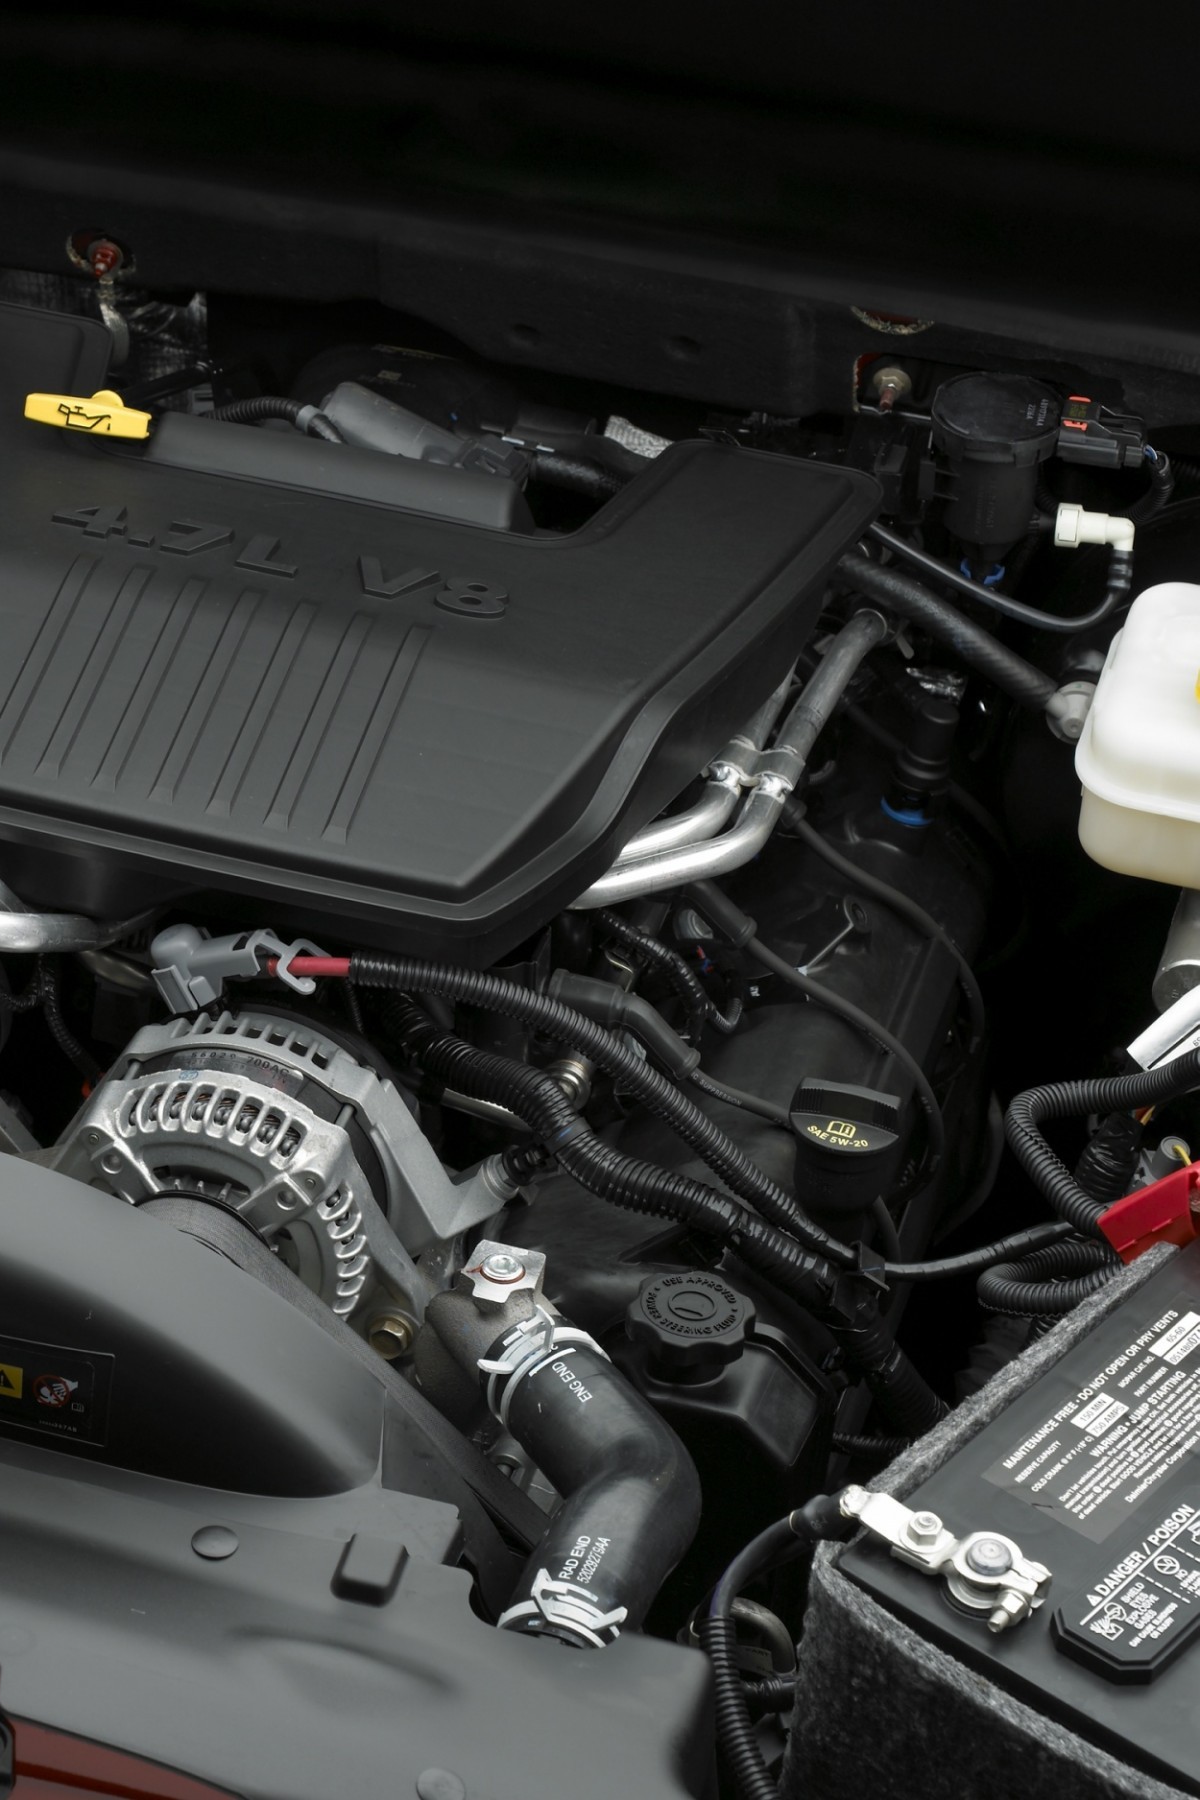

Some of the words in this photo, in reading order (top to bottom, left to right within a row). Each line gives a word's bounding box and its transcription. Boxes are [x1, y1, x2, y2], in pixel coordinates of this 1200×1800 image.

[51, 506, 299, 579] 4.7L
[358, 555, 510, 621] V8
[699, 1079, 742, 1106] SUPPRESSION
[807, 1125, 828, 1141] SAE
[829, 1134, 869, 1148] 5W-20
[662, 1276, 684, 1287] USE
[686, 1277, 737, 1304] APPROVED
[660, 1318, 713, 1335] STEERING
[551, 1361, 575, 1384] END
[1134, 1385, 1150, 1397] PART
[1145, 1366, 1169, 1386] NUMBER
[569, 1380, 594, 1403] ENG
[1003, 1420, 1060, 1469] MAINTENANCE
[1055, 1402, 1079, 1422] FREE
[1078, 1389, 1094, 1400] DO
[1089, 1375, 1109, 1390] NOT
[1105, 1355, 1130, 1375] OPEN
[1125, 1344, 1142, 1357] OR
[1136, 1332, 1155, 1346] PRY
[1150, 1310, 1179, 1334] VENTS
[1080, 1410, 1095, 1422] 150
[1091, 1399, 1107, 1413] MIN
[1089, 1425, 1129, 1459] WARNING
[1127, 1403, 1153, 1423] JUMP
[1147, 1371, 1187, 1405] STARTING
[1015, 1461, 1040, 1483] RESERVE
[1036, 1441, 1062, 1463] CAPACITY
[558, 1558, 578, 1581] RAD
[570, 1535, 591, 1559] END
[1094, 1551, 1147, 1596] DANGER
[1147, 1505, 1195, 1546] POISON
[1121, 1582, 1146, 1604] SHIELD
